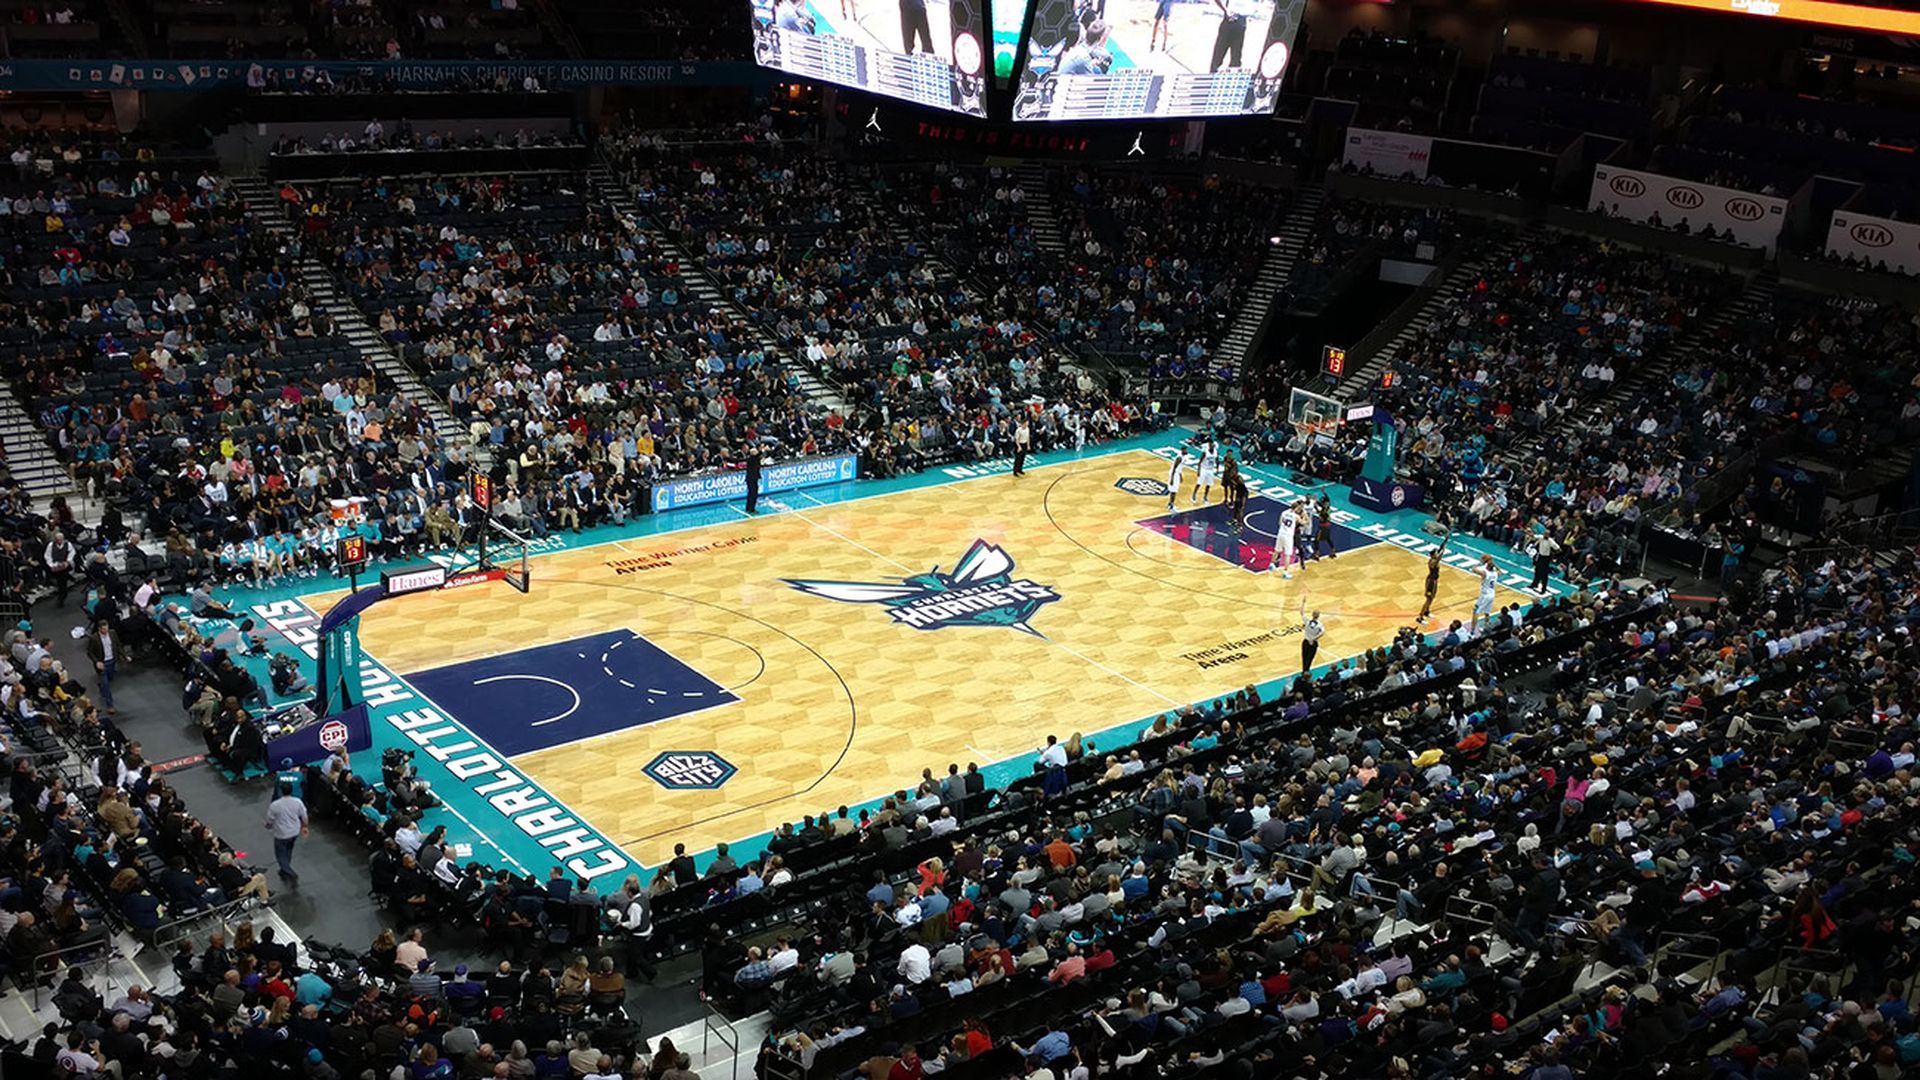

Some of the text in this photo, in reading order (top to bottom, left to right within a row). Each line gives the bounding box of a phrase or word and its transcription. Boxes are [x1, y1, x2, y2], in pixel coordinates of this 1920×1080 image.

[560, 65, 614, 81] CASINO
[619, 65, 674, 81] RESORT
[1615, 179, 1639, 194] KIA
[1671, 191, 1697, 205] KIA
[1731, 202, 1757, 217] KIA
[1856, 226, 1885, 244] KIA
[767, 470, 837, 488] EDUCATION LOTTERY
[768, 460, 837, 480] NORTH CAROLINA
[673, 485, 748, 503] EDUCATION LOTTERY
[674, 480, 704, 494] NORTH
[347, 547, 359, 559] 13
[602, 535, 759, 569] Time Warner Cable
[616, 560, 672, 576] Arena
[391, 571, 443, 590] Hanes
[890, 579, 1054, 628] HORNETS
[911, 582, 1002, 607] CHARLOTTE
[1180, 646, 1223, 661] Time
[1220, 633, 1274, 652] Warner
[1198, 652, 1250, 670] Arena
[322, 728, 346, 742] CPI
[653, 755, 716, 778] BUZZ
[668, 763, 724, 785] CITY
[385, 706, 629, 881] CHARLOTTE
